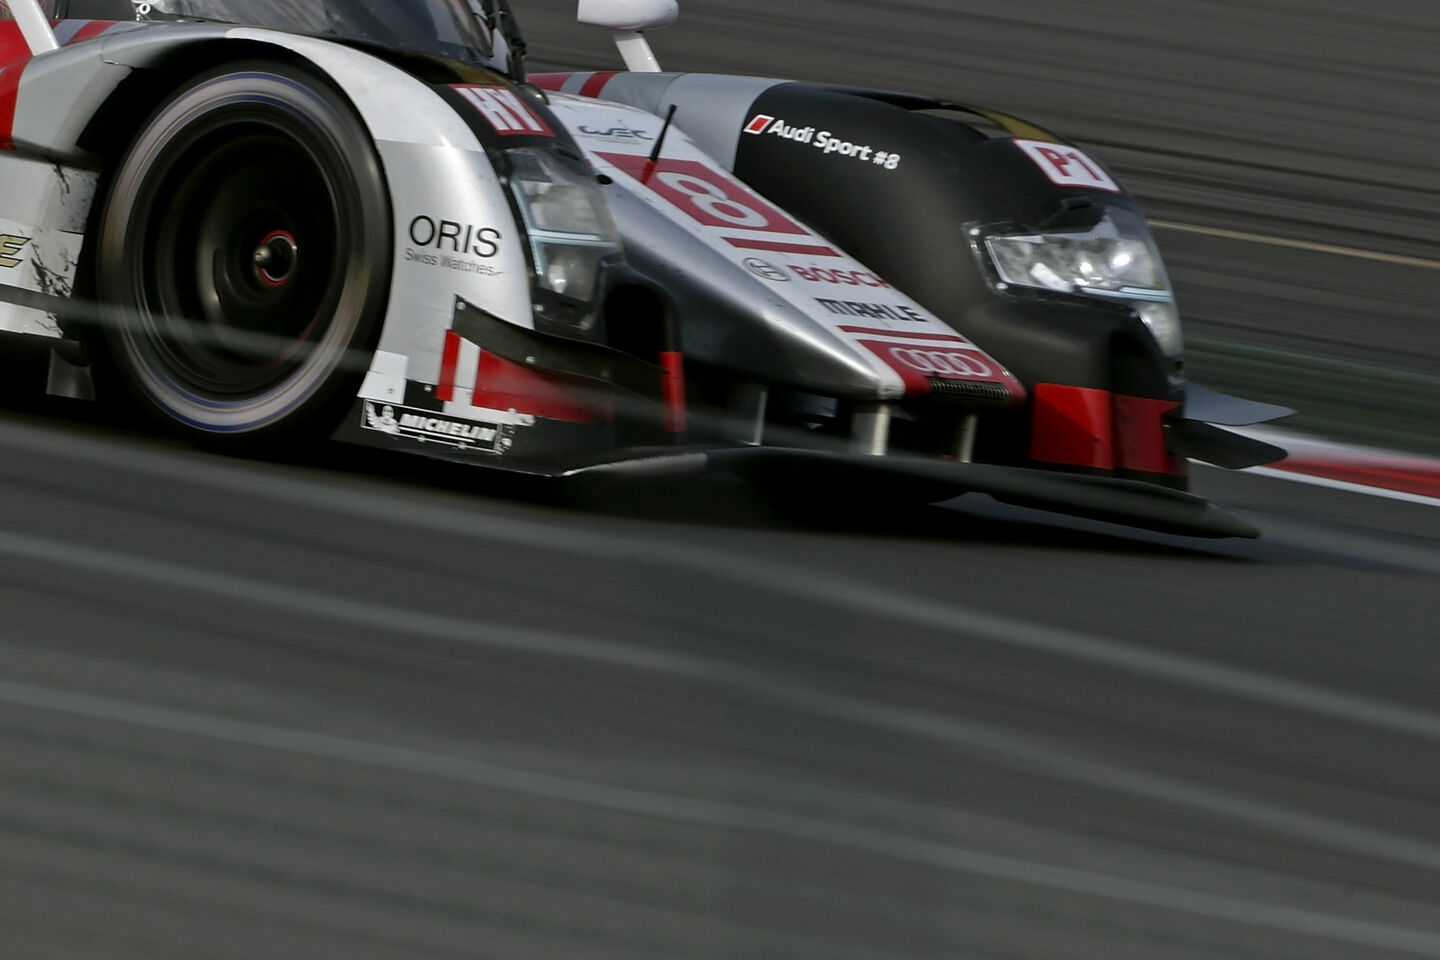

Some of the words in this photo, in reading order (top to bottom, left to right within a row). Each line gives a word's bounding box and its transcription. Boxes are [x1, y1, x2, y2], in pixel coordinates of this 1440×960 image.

[454, 86, 543, 132] HY
[767, 120, 814, 144] Audi
[813, 131, 873, 162] Sport
[872, 150, 902, 170] #8
[1035, 146, 1105, 181] P1
[657, 171, 769, 227] 8
[409, 214, 502, 258] ORIS
[404, 248, 438, 266] Swiss
[440, 252, 495, 277] Watches
[813, 297, 929, 323] MAHLE
[399, 413, 497, 442] MICHELIN
